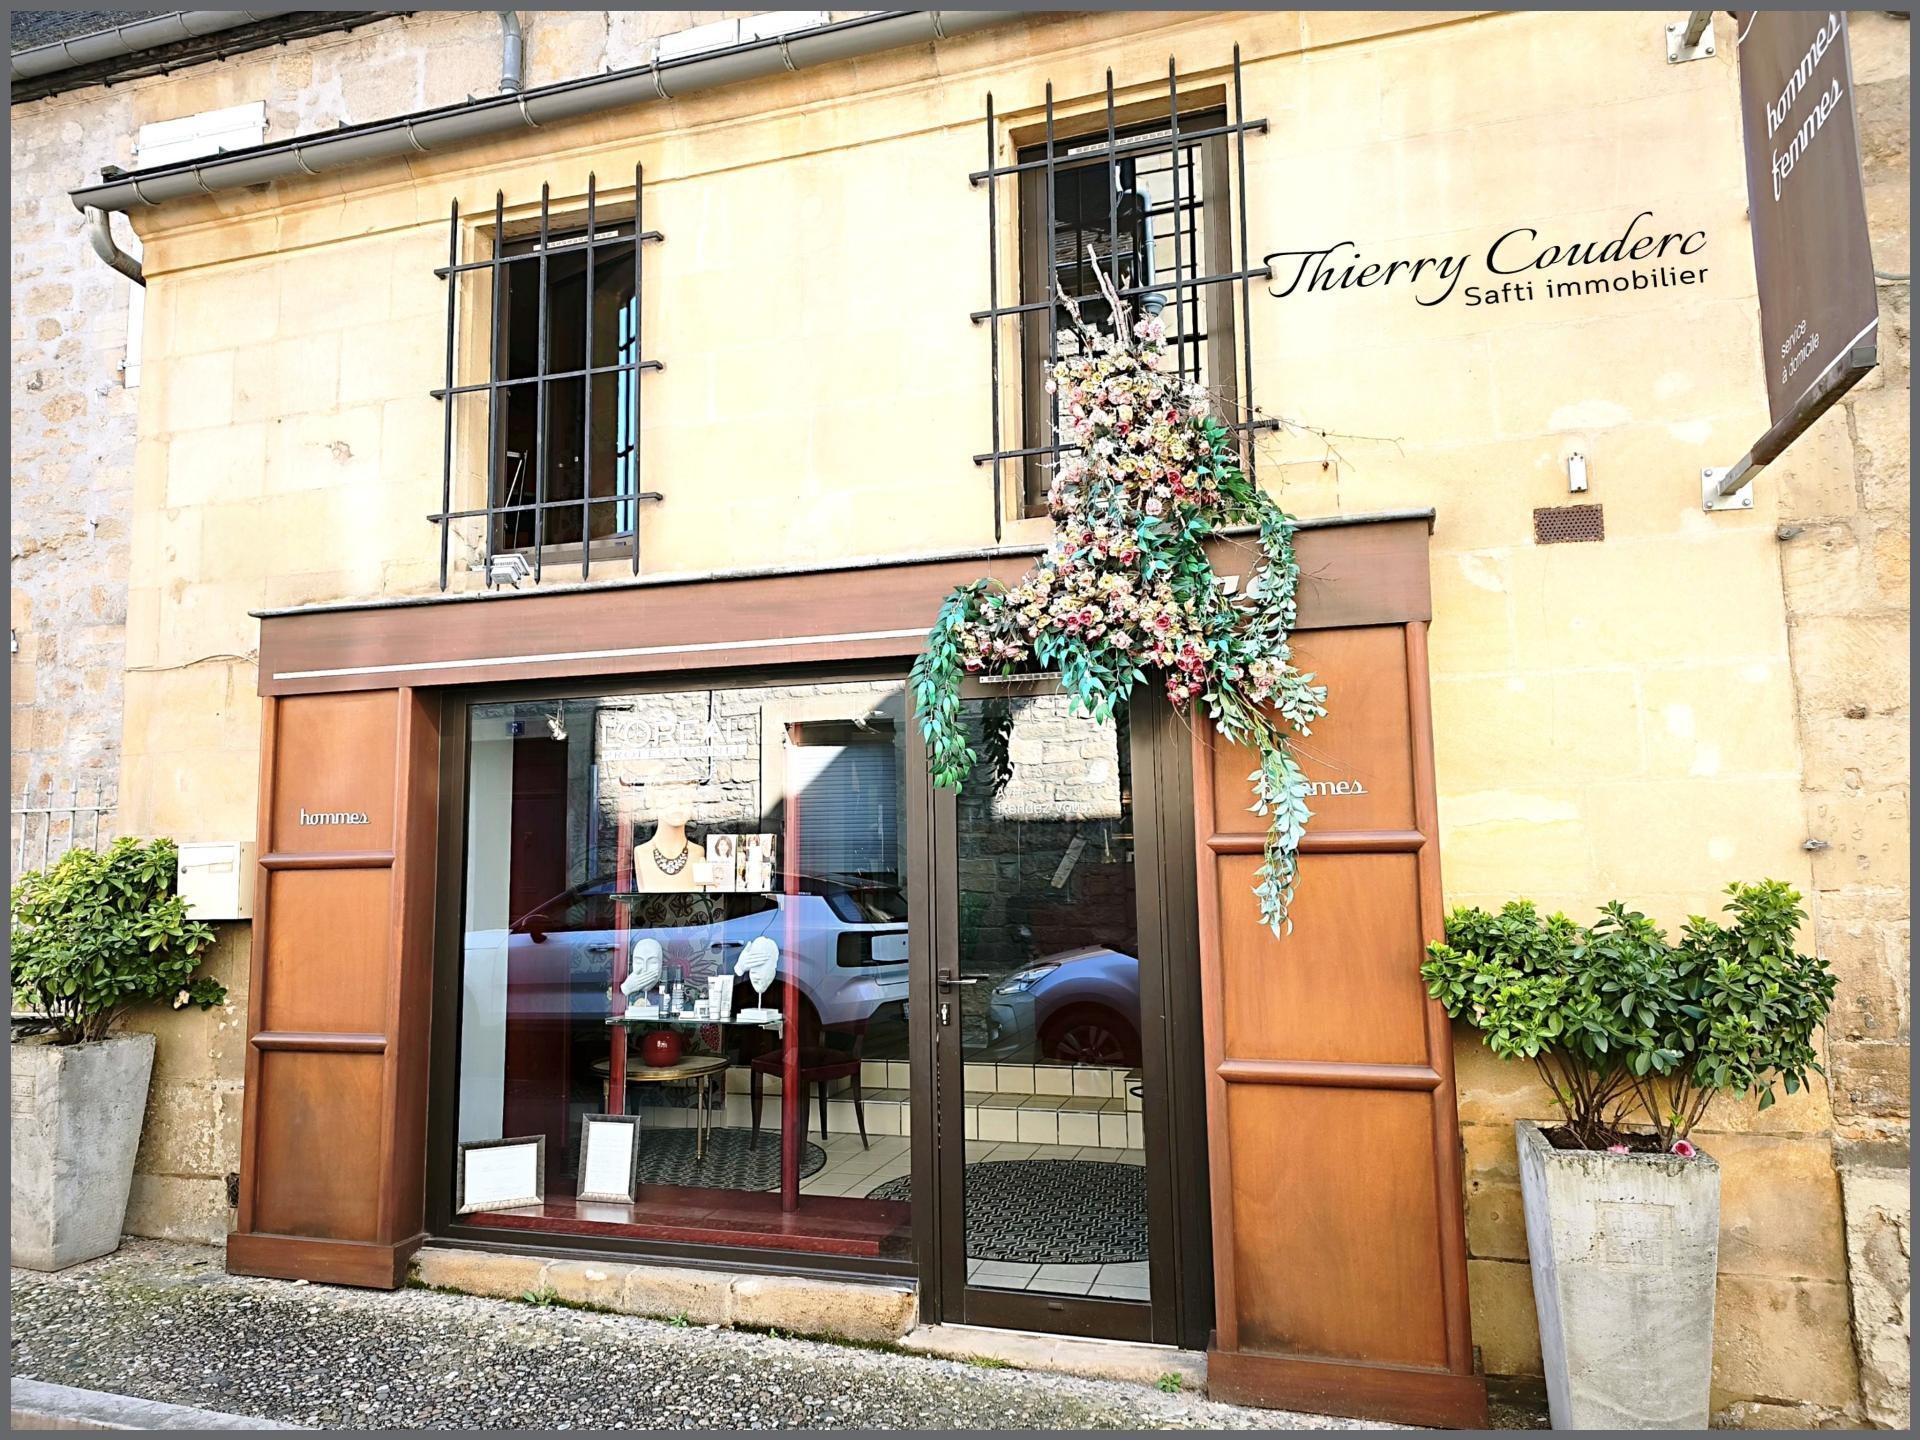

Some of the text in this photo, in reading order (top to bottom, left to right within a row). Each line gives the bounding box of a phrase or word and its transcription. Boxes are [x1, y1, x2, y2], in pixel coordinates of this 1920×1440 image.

[1766, 12, 1841, 140] hommes
[1771, 77, 1843, 202] femmes
[1781, 319, 1806, 359] service
[1788, 333, 1819, 377] domicile
[300, 808, 371, 826] hommes
